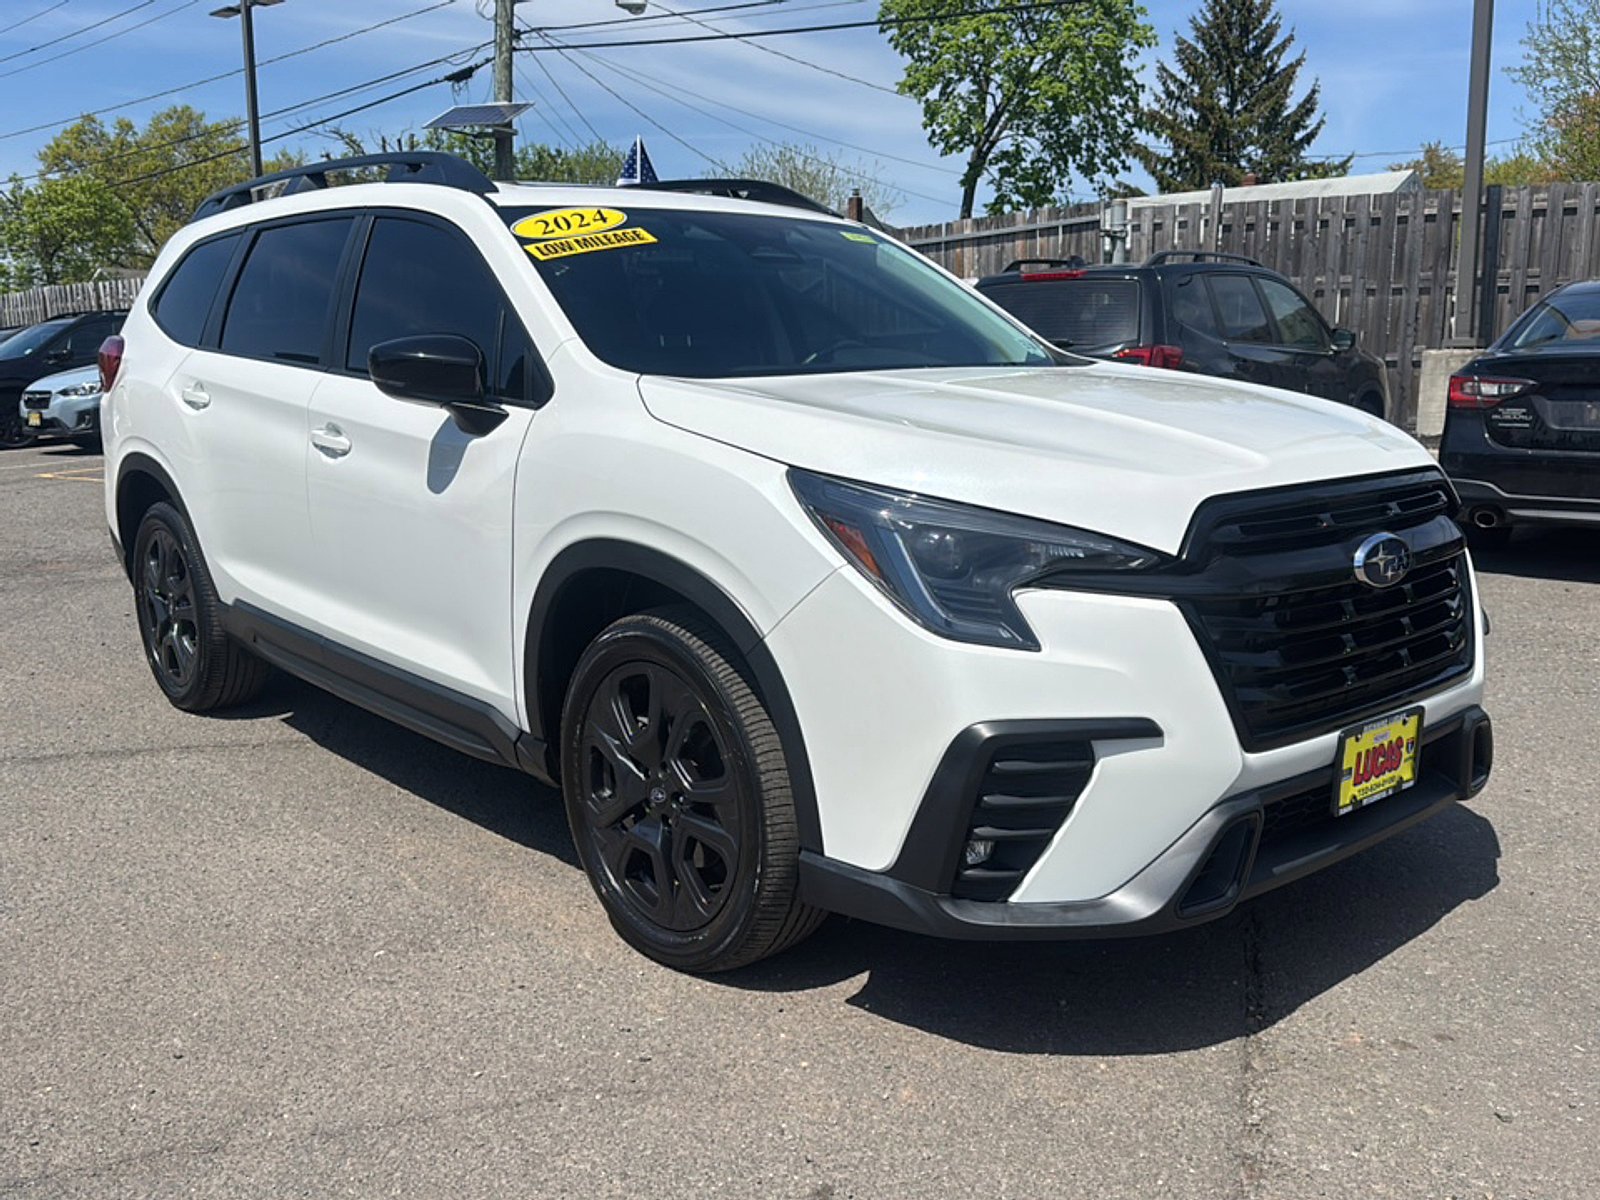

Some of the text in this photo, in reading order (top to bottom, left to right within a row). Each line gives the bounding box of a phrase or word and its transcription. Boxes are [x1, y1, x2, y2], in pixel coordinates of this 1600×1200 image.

[535, 209, 608, 235] 2024
[535, 230, 646, 257] LOW MILEAGE
[1353, 736, 1405, 787] LUCAS
